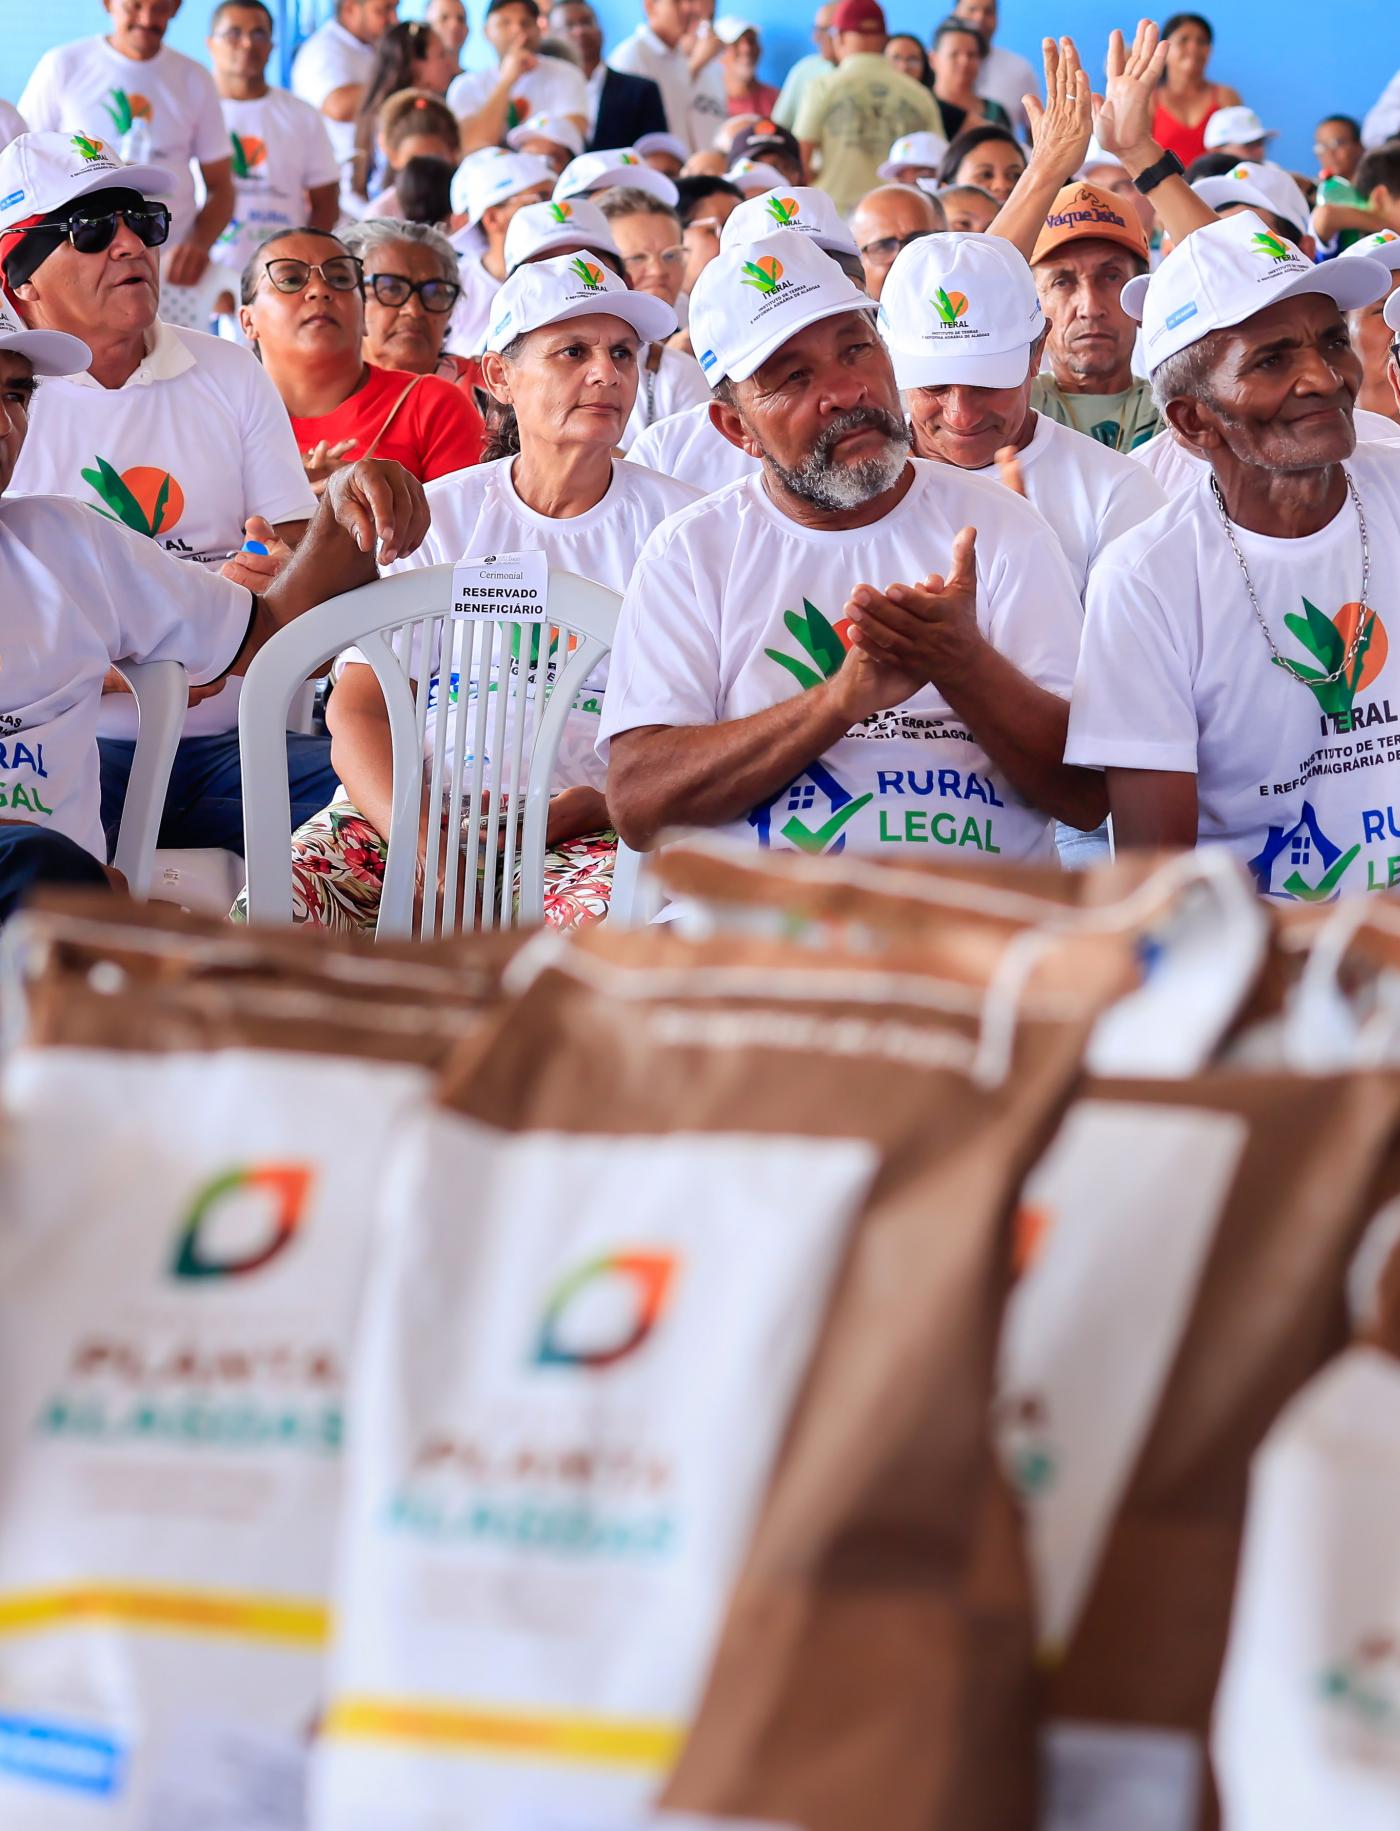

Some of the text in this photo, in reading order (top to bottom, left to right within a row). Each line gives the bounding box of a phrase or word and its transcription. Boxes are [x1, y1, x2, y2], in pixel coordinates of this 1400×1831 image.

[1273, 254, 1301, 265] ITERAL
[583, 283, 609, 292] ITERAL
[762, 279, 794, 300] ITERAL
[940, 320, 969, 329] ITERAL
[480, 570, 524, 581] Cerimonial
[462, 587, 538, 599] RESERVADO
[454, 602, 544, 615] BENEFICIÁRIO
[891, 716, 945, 729] TERRAS
[1319, 699, 1399, 737] ITERAL
[902, 730, 921, 740] DE
[924, 729, 975, 744] ALAGOA
[0, 742, 48, 778] RAL
[1299, 746, 1353, 773] INSTITUTO
[1356, 739, 1374, 754] DE
[1259, 785, 1269, 797] E
[1273, 764, 1328, 795] REFORMA
[1326, 755, 1385, 775] AGRÁRIA
[876, 769, 1004, 808] RURAL
[0, 782, 53, 816] GAL
[879, 810, 1001, 854] LEGAL
